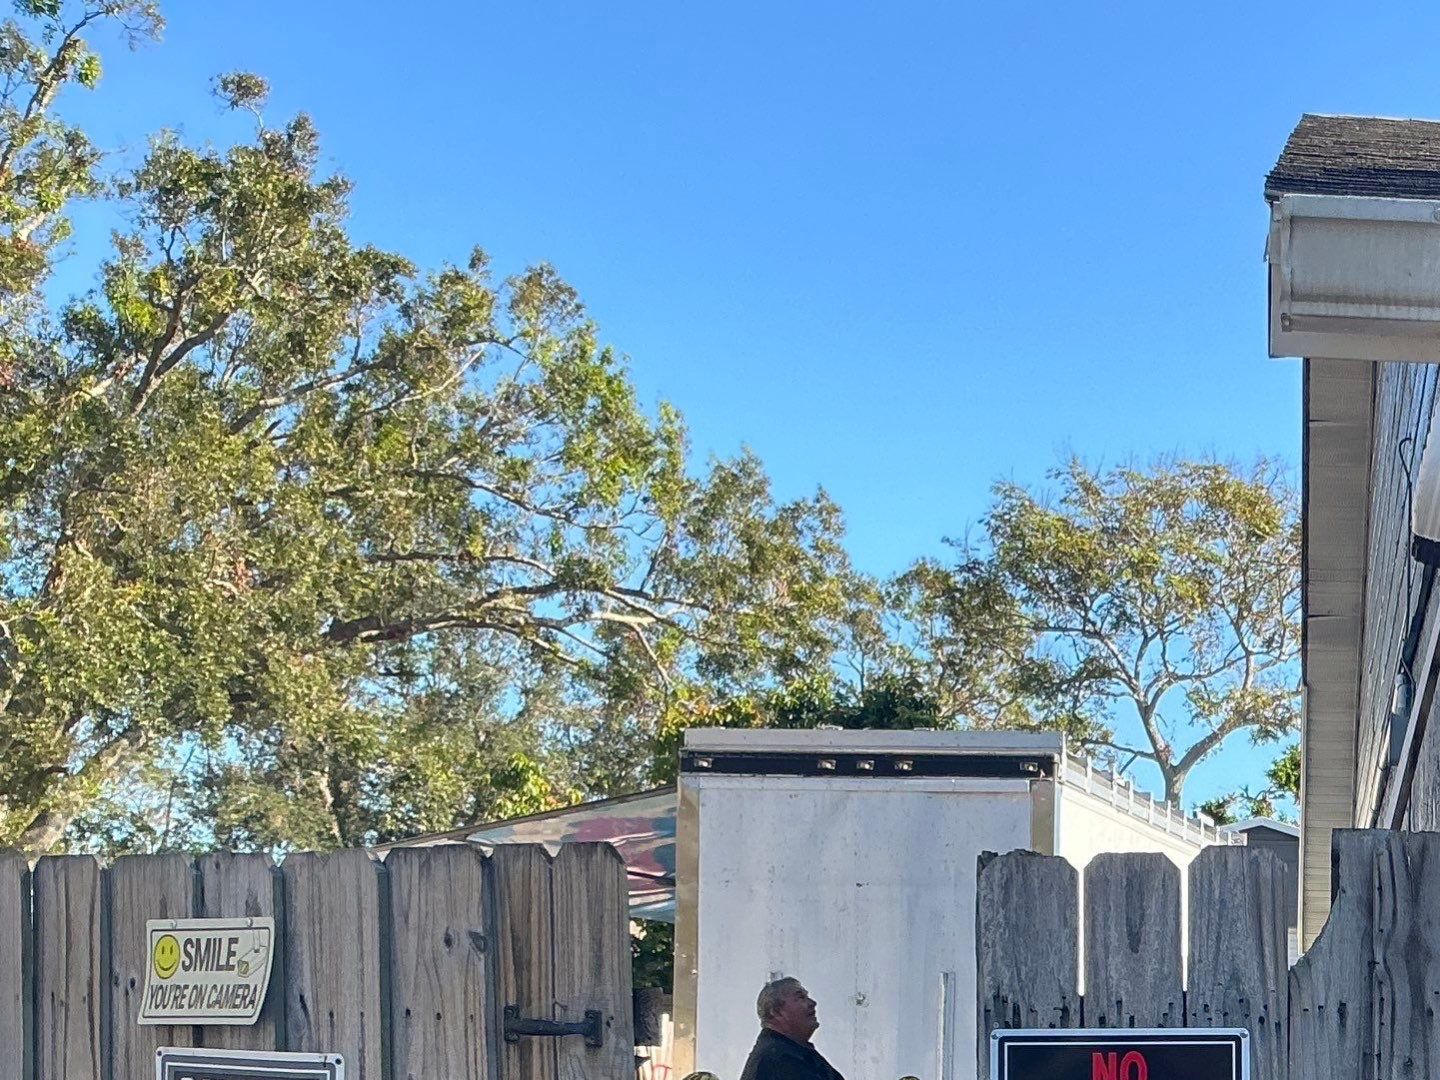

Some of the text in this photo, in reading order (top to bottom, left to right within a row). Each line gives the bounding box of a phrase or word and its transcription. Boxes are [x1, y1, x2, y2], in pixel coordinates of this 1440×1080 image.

[182, 937, 239, 972] SMILE
[149, 983, 258, 1010] YOU'RE ON CAMERA
